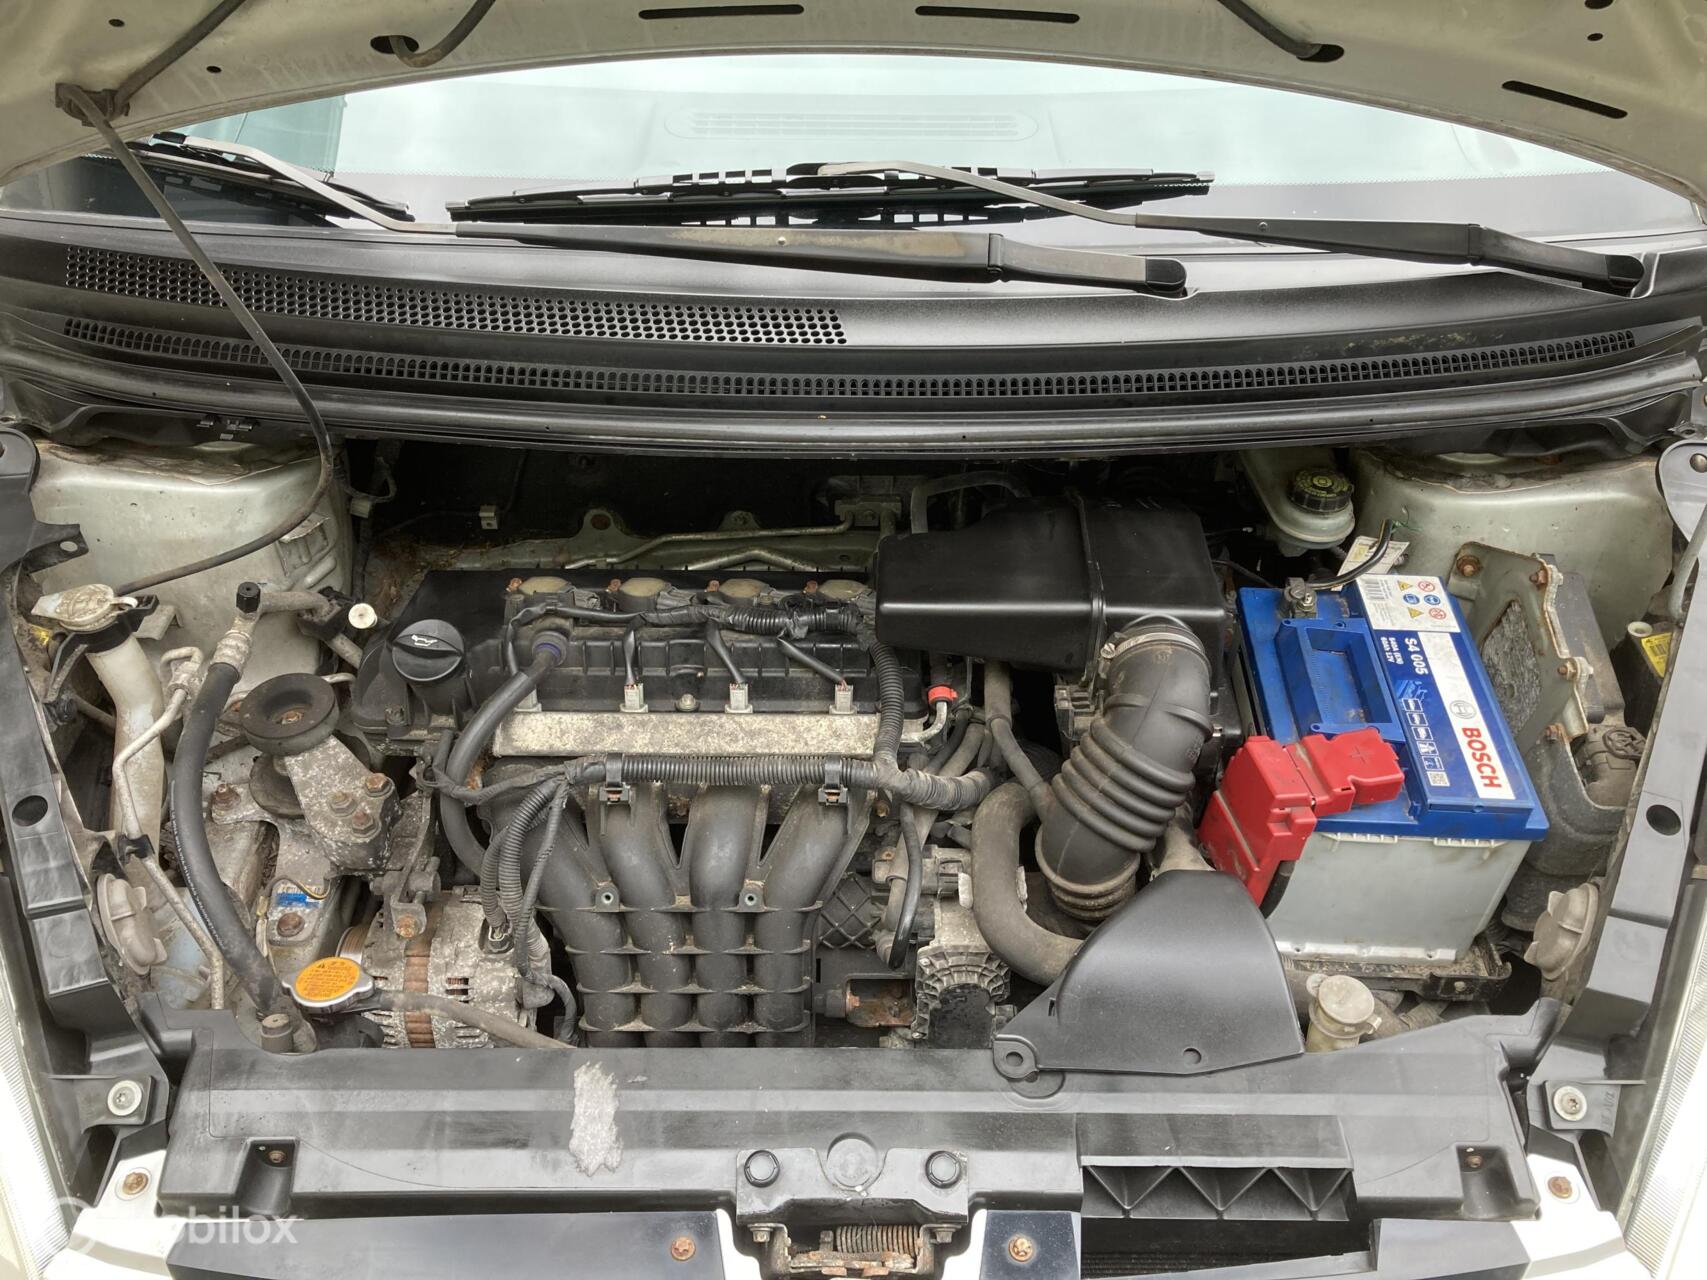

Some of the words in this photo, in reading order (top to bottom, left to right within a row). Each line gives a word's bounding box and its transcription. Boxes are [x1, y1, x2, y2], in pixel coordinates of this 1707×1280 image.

[1405, 637, 1420, 651] S4
[1410, 654, 1429, 675] 005
[1462, 727, 1502, 788] BOSCH
